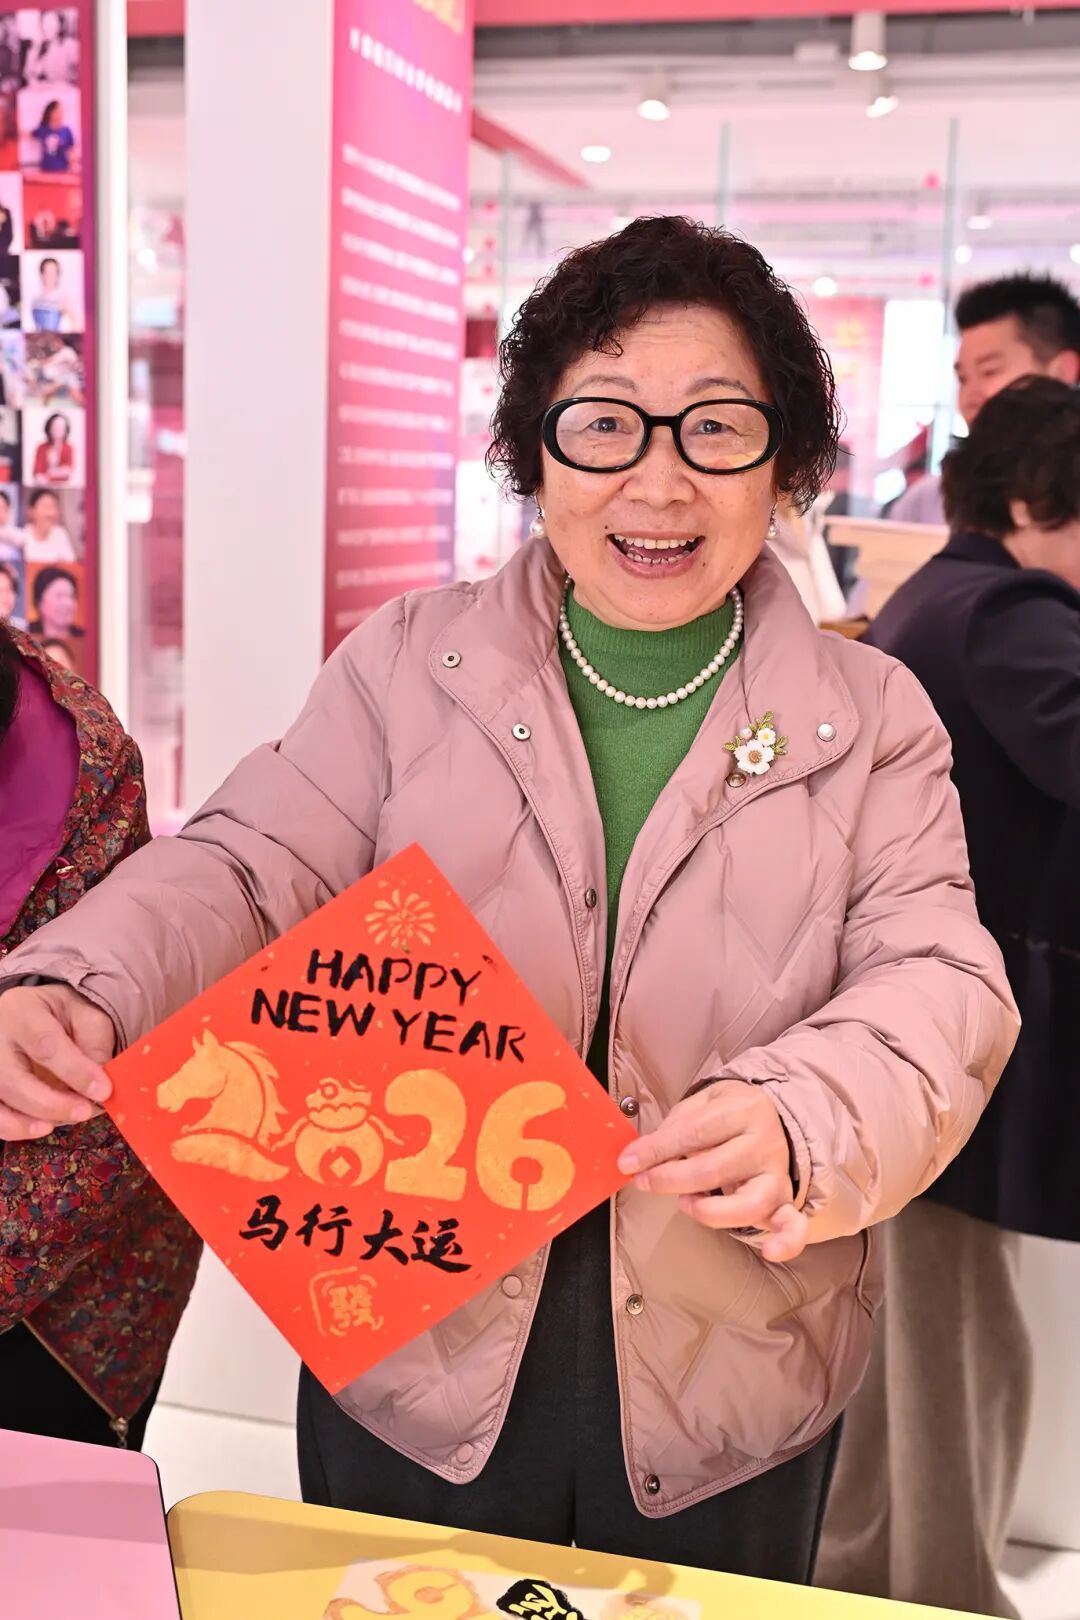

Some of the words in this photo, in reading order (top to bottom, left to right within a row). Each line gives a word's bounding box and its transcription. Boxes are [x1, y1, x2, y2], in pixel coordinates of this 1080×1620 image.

[307, 948, 482, 1006] HAPPY
[251, 988, 376, 1037] NEW
[392, 1008, 526, 1063] YEAR
[239, 1194, 473, 1273] 马行大运
